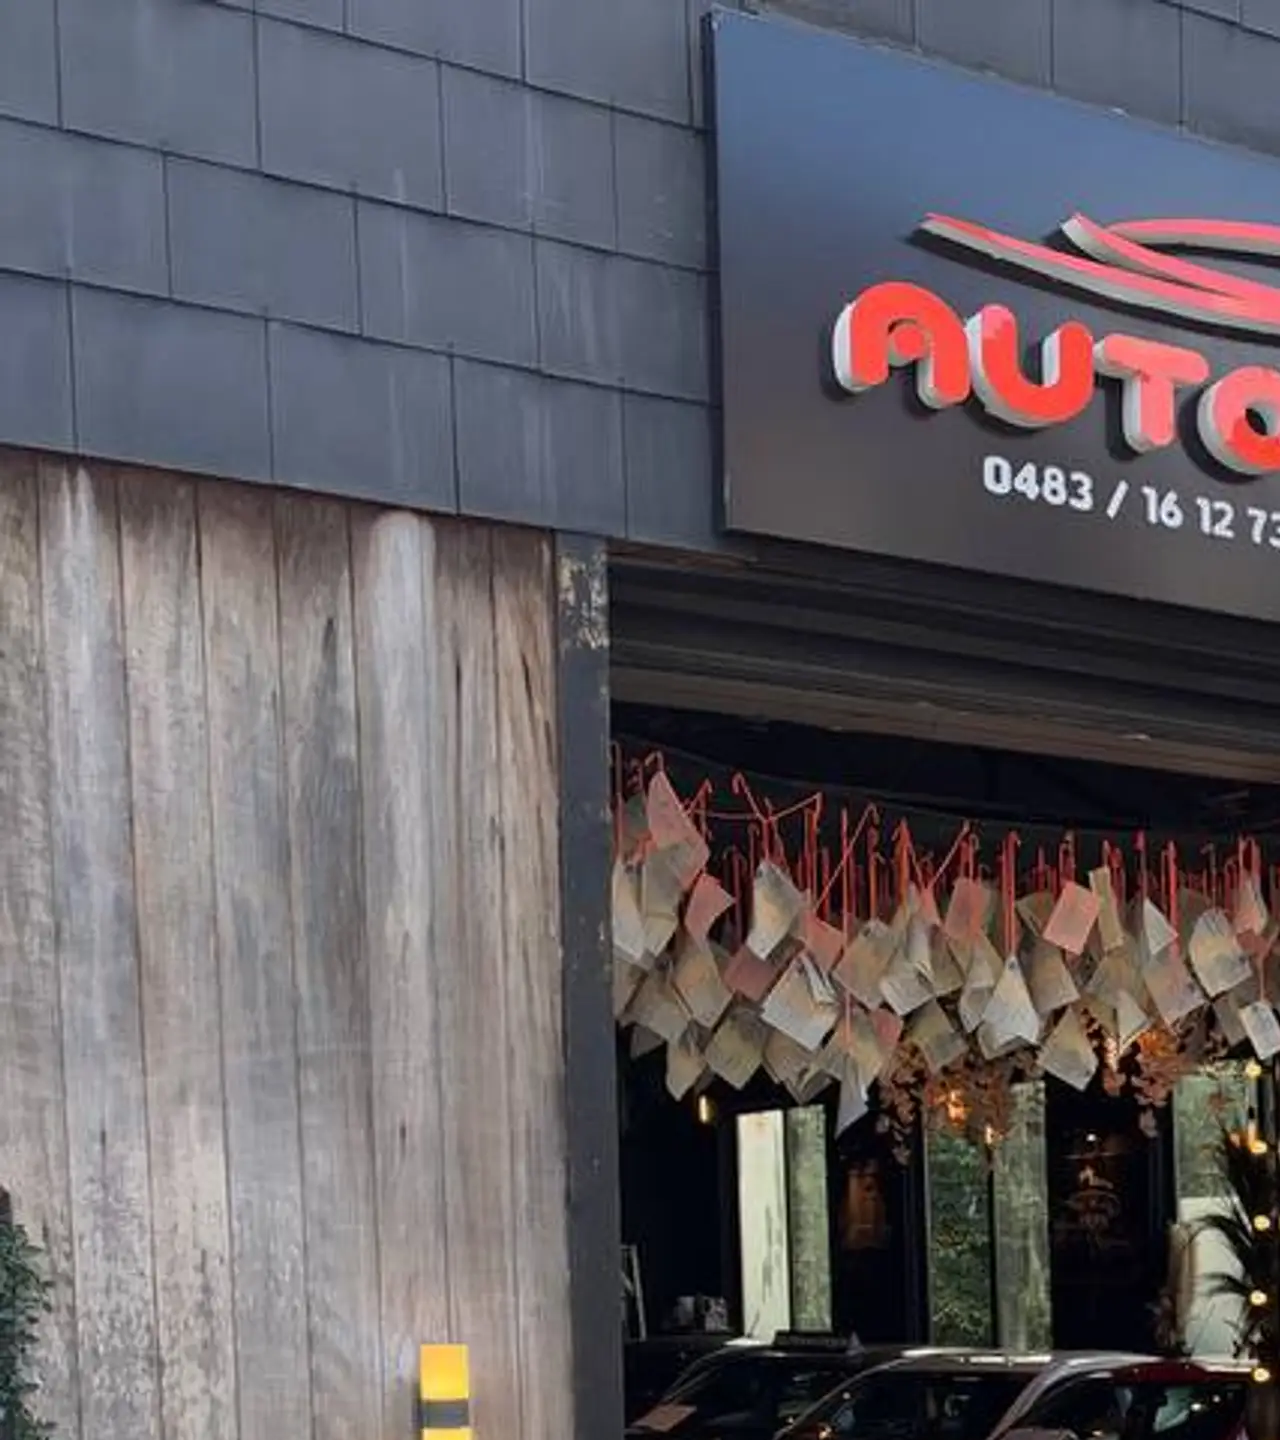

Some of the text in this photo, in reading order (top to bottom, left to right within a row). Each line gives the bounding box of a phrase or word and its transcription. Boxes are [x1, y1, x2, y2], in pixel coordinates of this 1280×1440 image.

[983, 455, 1094, 511] 0483
[1141, 485, 1184, 528] 16
[1195, 496, 1235, 538] 12
